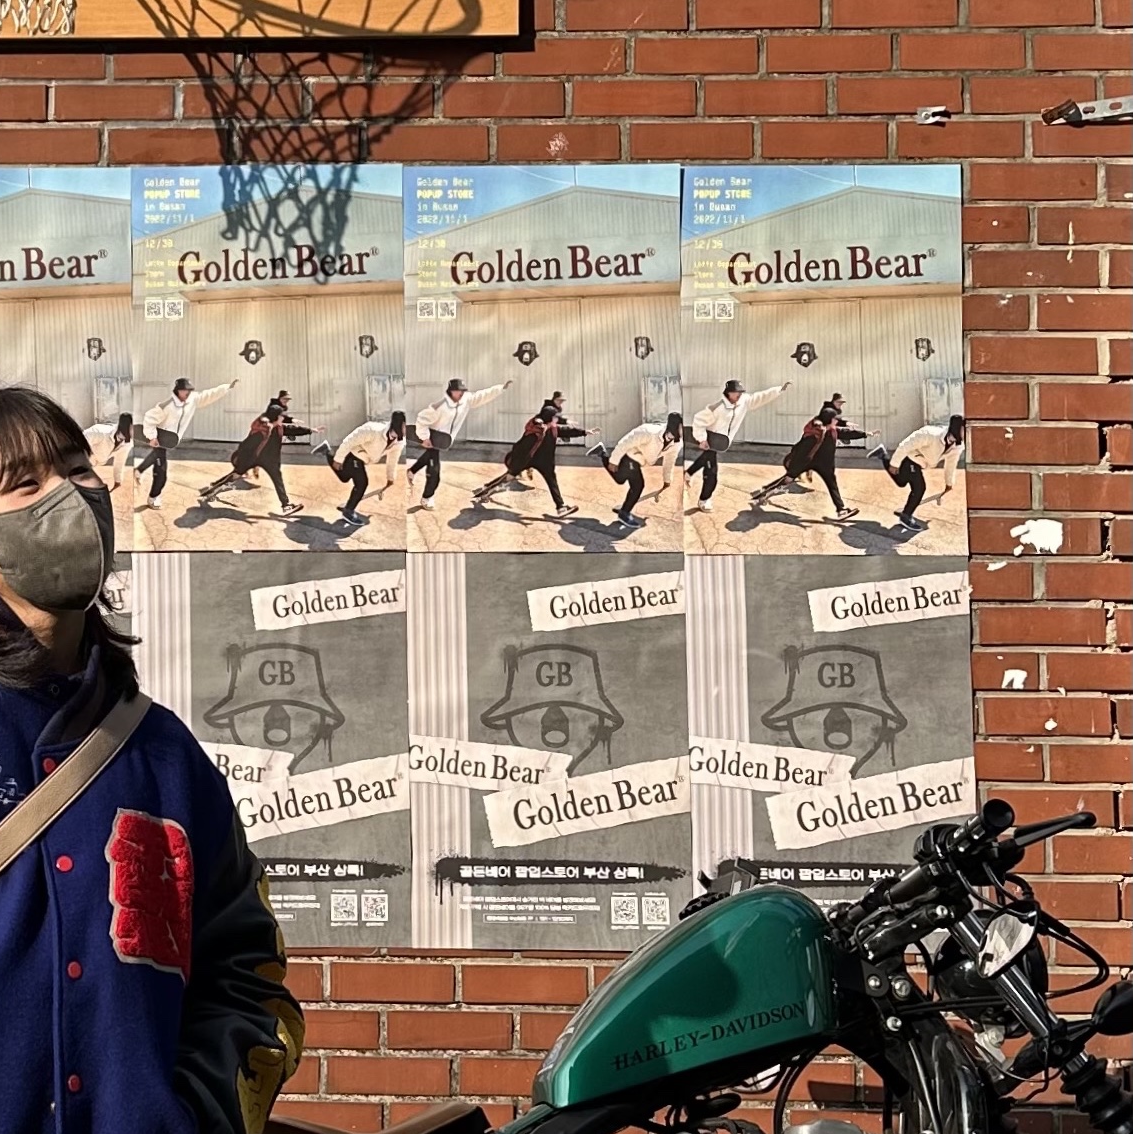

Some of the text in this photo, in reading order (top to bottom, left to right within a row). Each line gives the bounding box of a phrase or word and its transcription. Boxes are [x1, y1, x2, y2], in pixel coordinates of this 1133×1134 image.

[177, 249, 289, 285] Golden
[451, 249, 563, 284] Golden
[728, 249, 842, 285] Golden
[272, 584, 348, 619] Golden
[549, 586, 625, 620] Golden
[830, 585, 910, 621] Golden
[258, 659, 296, 687] GB
[535, 660, 574, 688] GB
[817, 662, 857, 689] GB
[409, 744, 487, 779] Golden
[689, 746, 768, 781] Golden
[237, 788, 333, 828] Golden
[513, 790, 613, 832] Golden
[796, 792, 899, 833] Golden
[265, 864, 300, 876] 스토어
[304, 865, 330, 876] 부산
[460, 866, 511, 878] 골든베어
[515, 866, 579, 878] 팝업스토어
[583, 866, 610, 879] 부산
[798, 869, 864, 881] 팝업스토어
[612, 1000, 807, 1071] HARLEY-DAVIDSON
